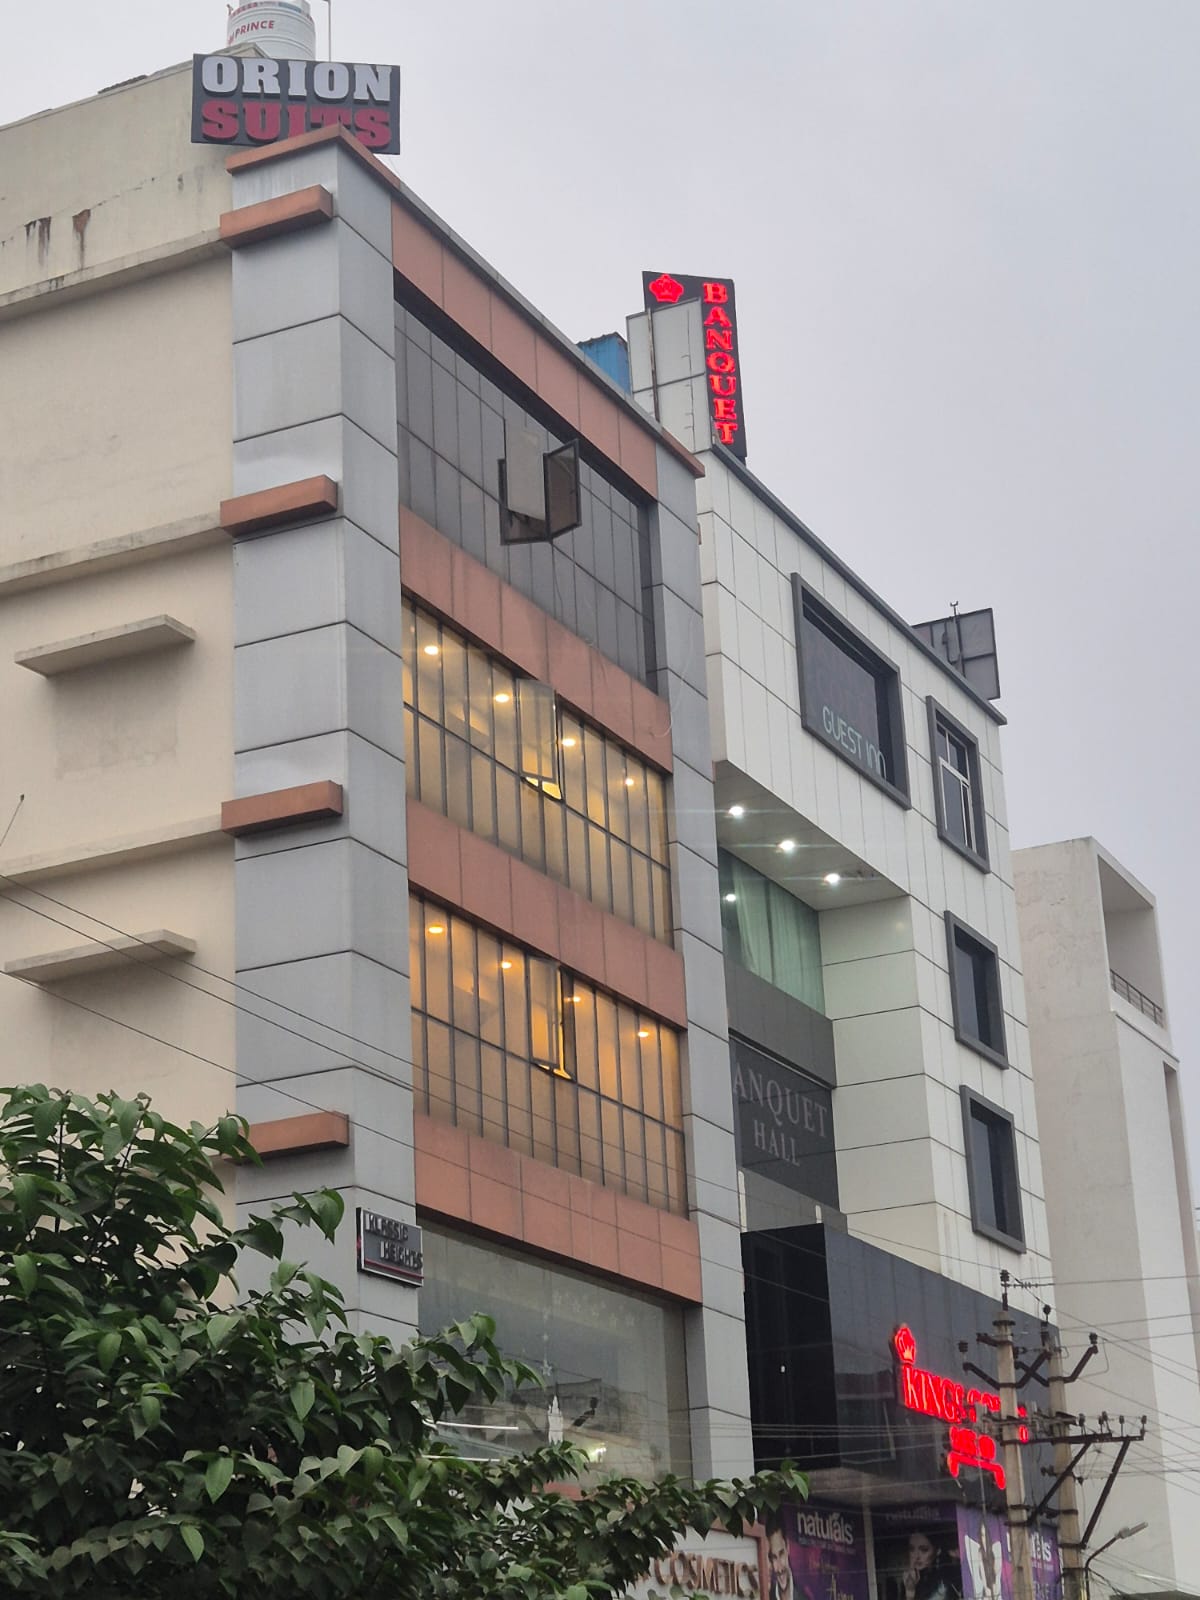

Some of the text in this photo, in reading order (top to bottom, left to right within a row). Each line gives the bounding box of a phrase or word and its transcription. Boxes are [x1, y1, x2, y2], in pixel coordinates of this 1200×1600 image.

[235, 20, 275, 38] PRINCE
[202, 56, 392, 102] ORION
[703, 282, 739, 444] BANQUET
[822, 705, 862, 760] GUEST
[732, 1062, 828, 1138] ANQUET
[754, 1119, 800, 1167] HALL
[903, 1365, 967, 1425] KINGS
[797, 1511, 854, 1545] naturals
[653, 1550, 760, 1599] COSMETICS
